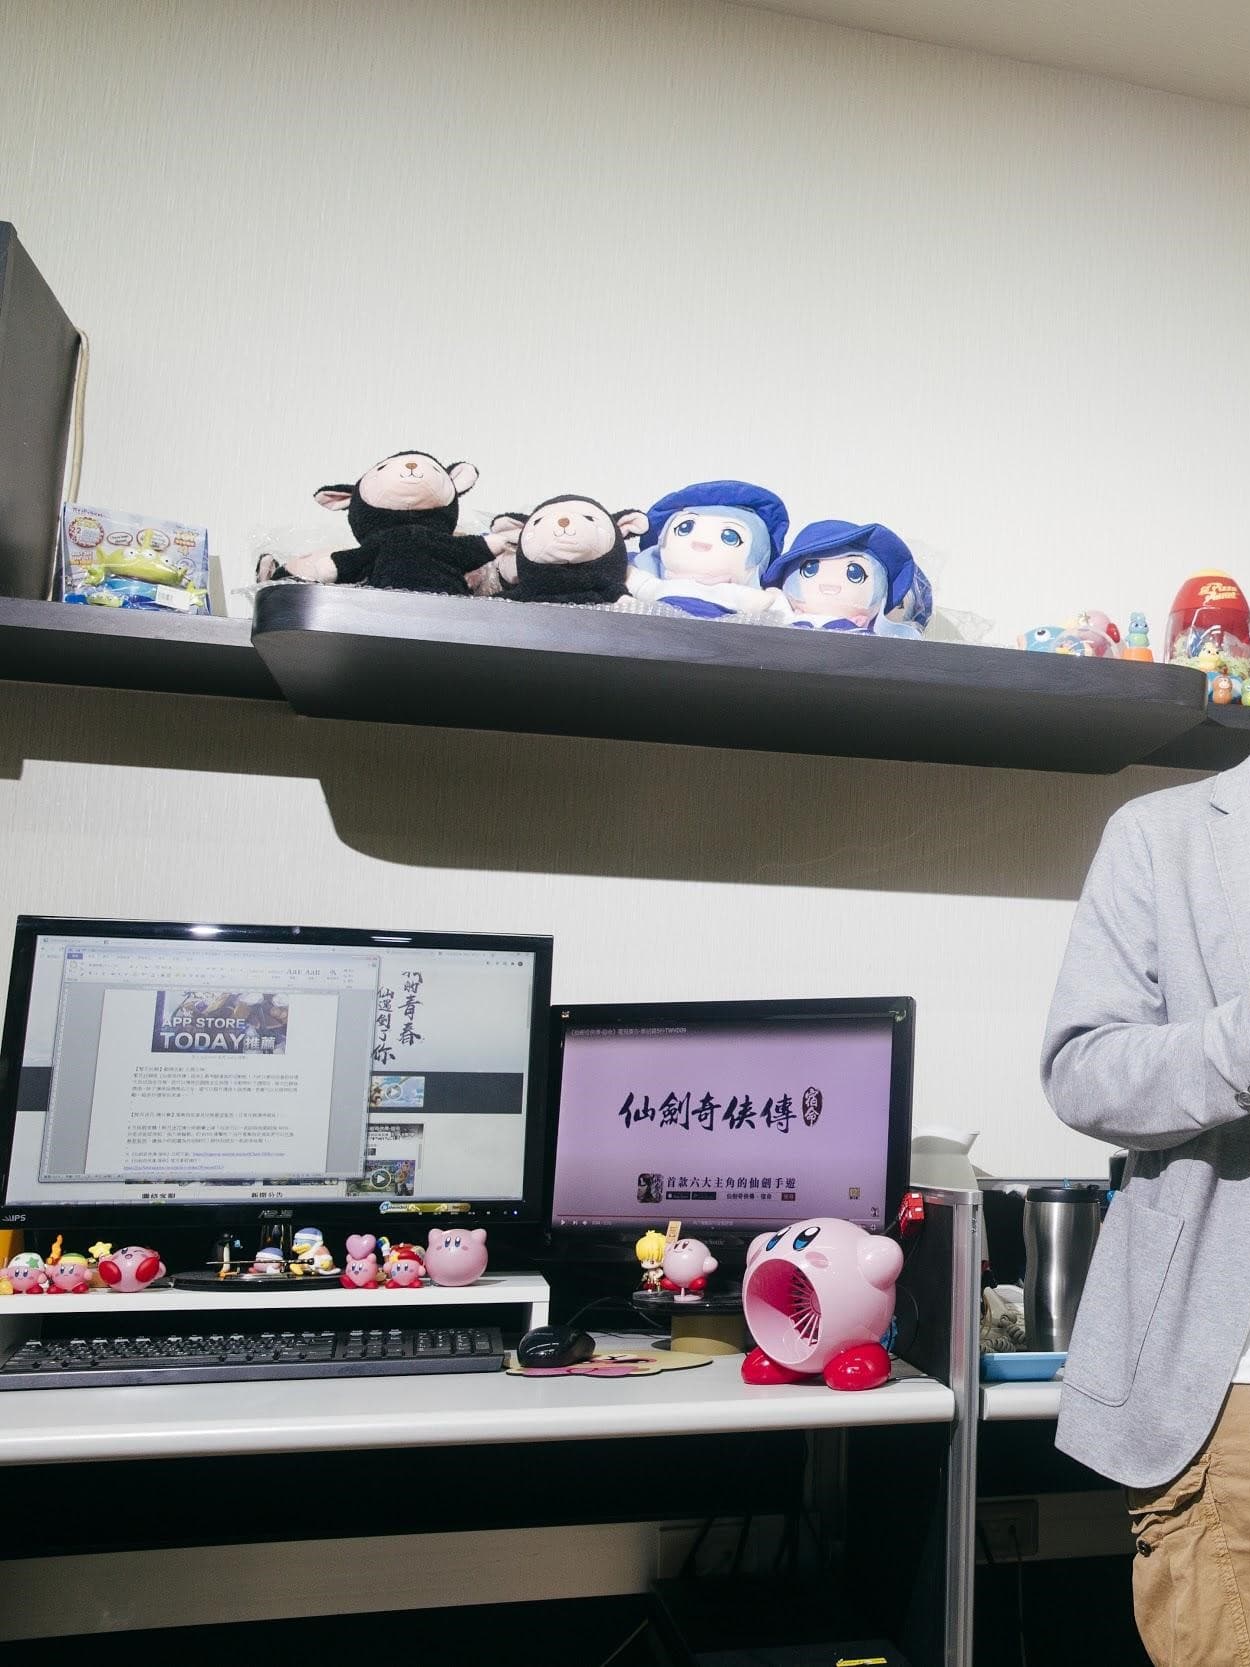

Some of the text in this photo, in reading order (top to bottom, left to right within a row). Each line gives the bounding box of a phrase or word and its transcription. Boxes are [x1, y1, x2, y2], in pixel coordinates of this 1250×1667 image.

[162, 1017, 246, 1030] APP STORE
[618, 1087, 822, 1134] 仙劍奇俠傳 宿命
[666, 1176, 796, 1190] 首款六大主角的仙劍手遊
